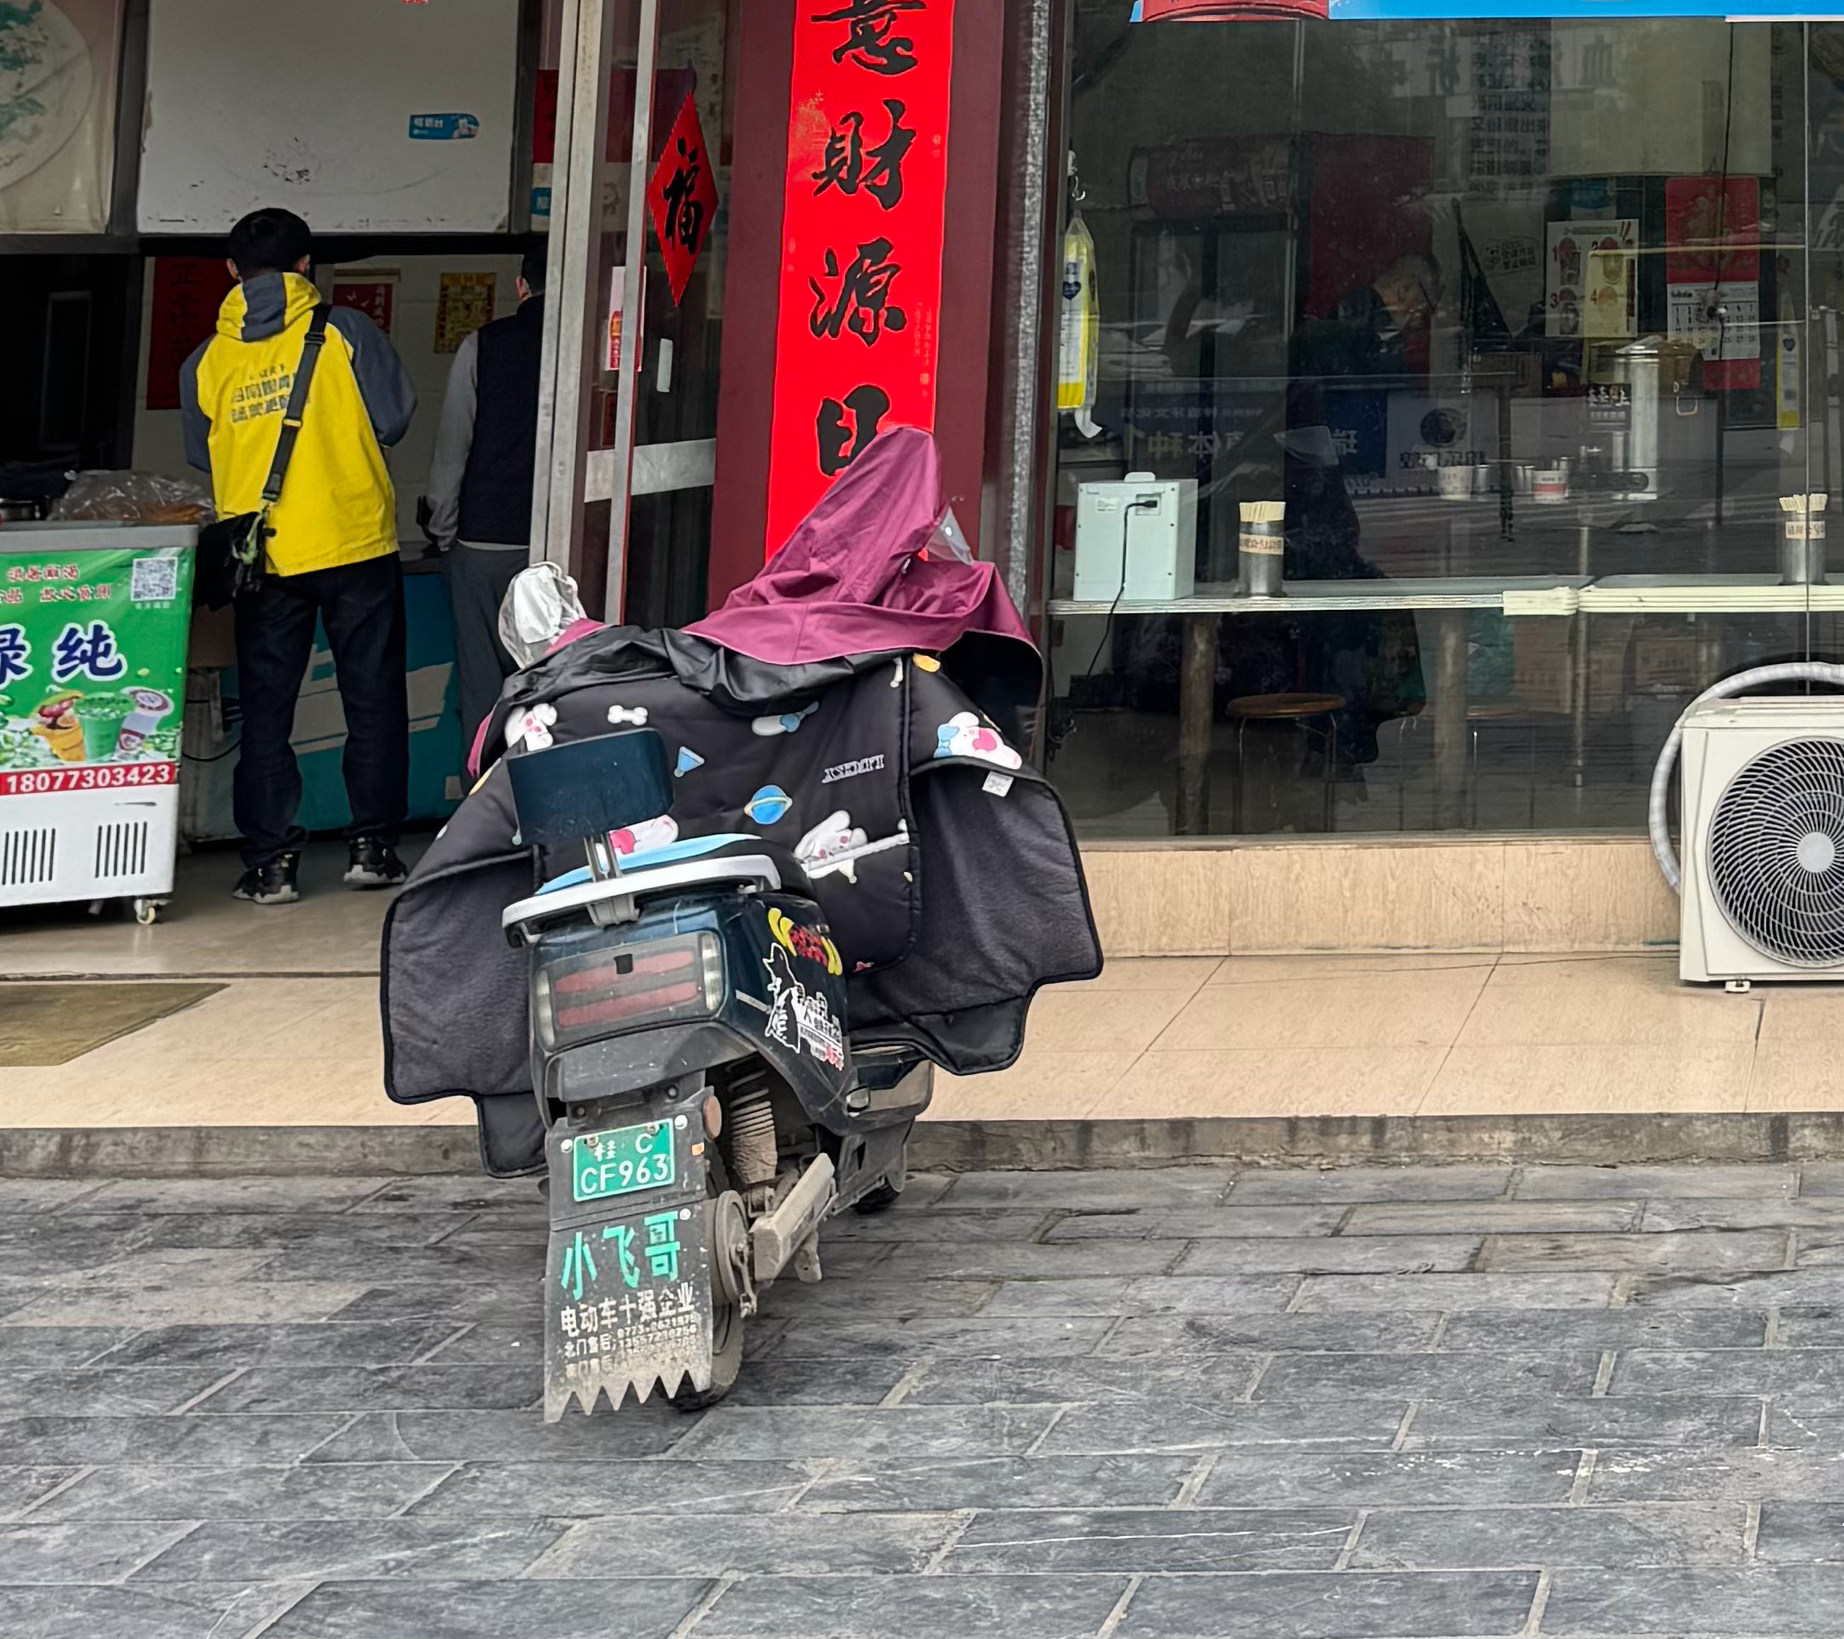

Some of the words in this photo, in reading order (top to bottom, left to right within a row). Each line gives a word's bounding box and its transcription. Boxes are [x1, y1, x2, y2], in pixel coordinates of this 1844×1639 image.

[662, 138, 704, 256] 福
[6, 764, 171, 794] 18077303423
[593, 1140, 616, 1163] 桂
[634, 1133, 654, 1155] C
[580, 1153, 669, 1195] CF963
[560, 1209, 681, 1301] 小飞哥
[560, 1281, 695, 1338] 电动车十强企业
